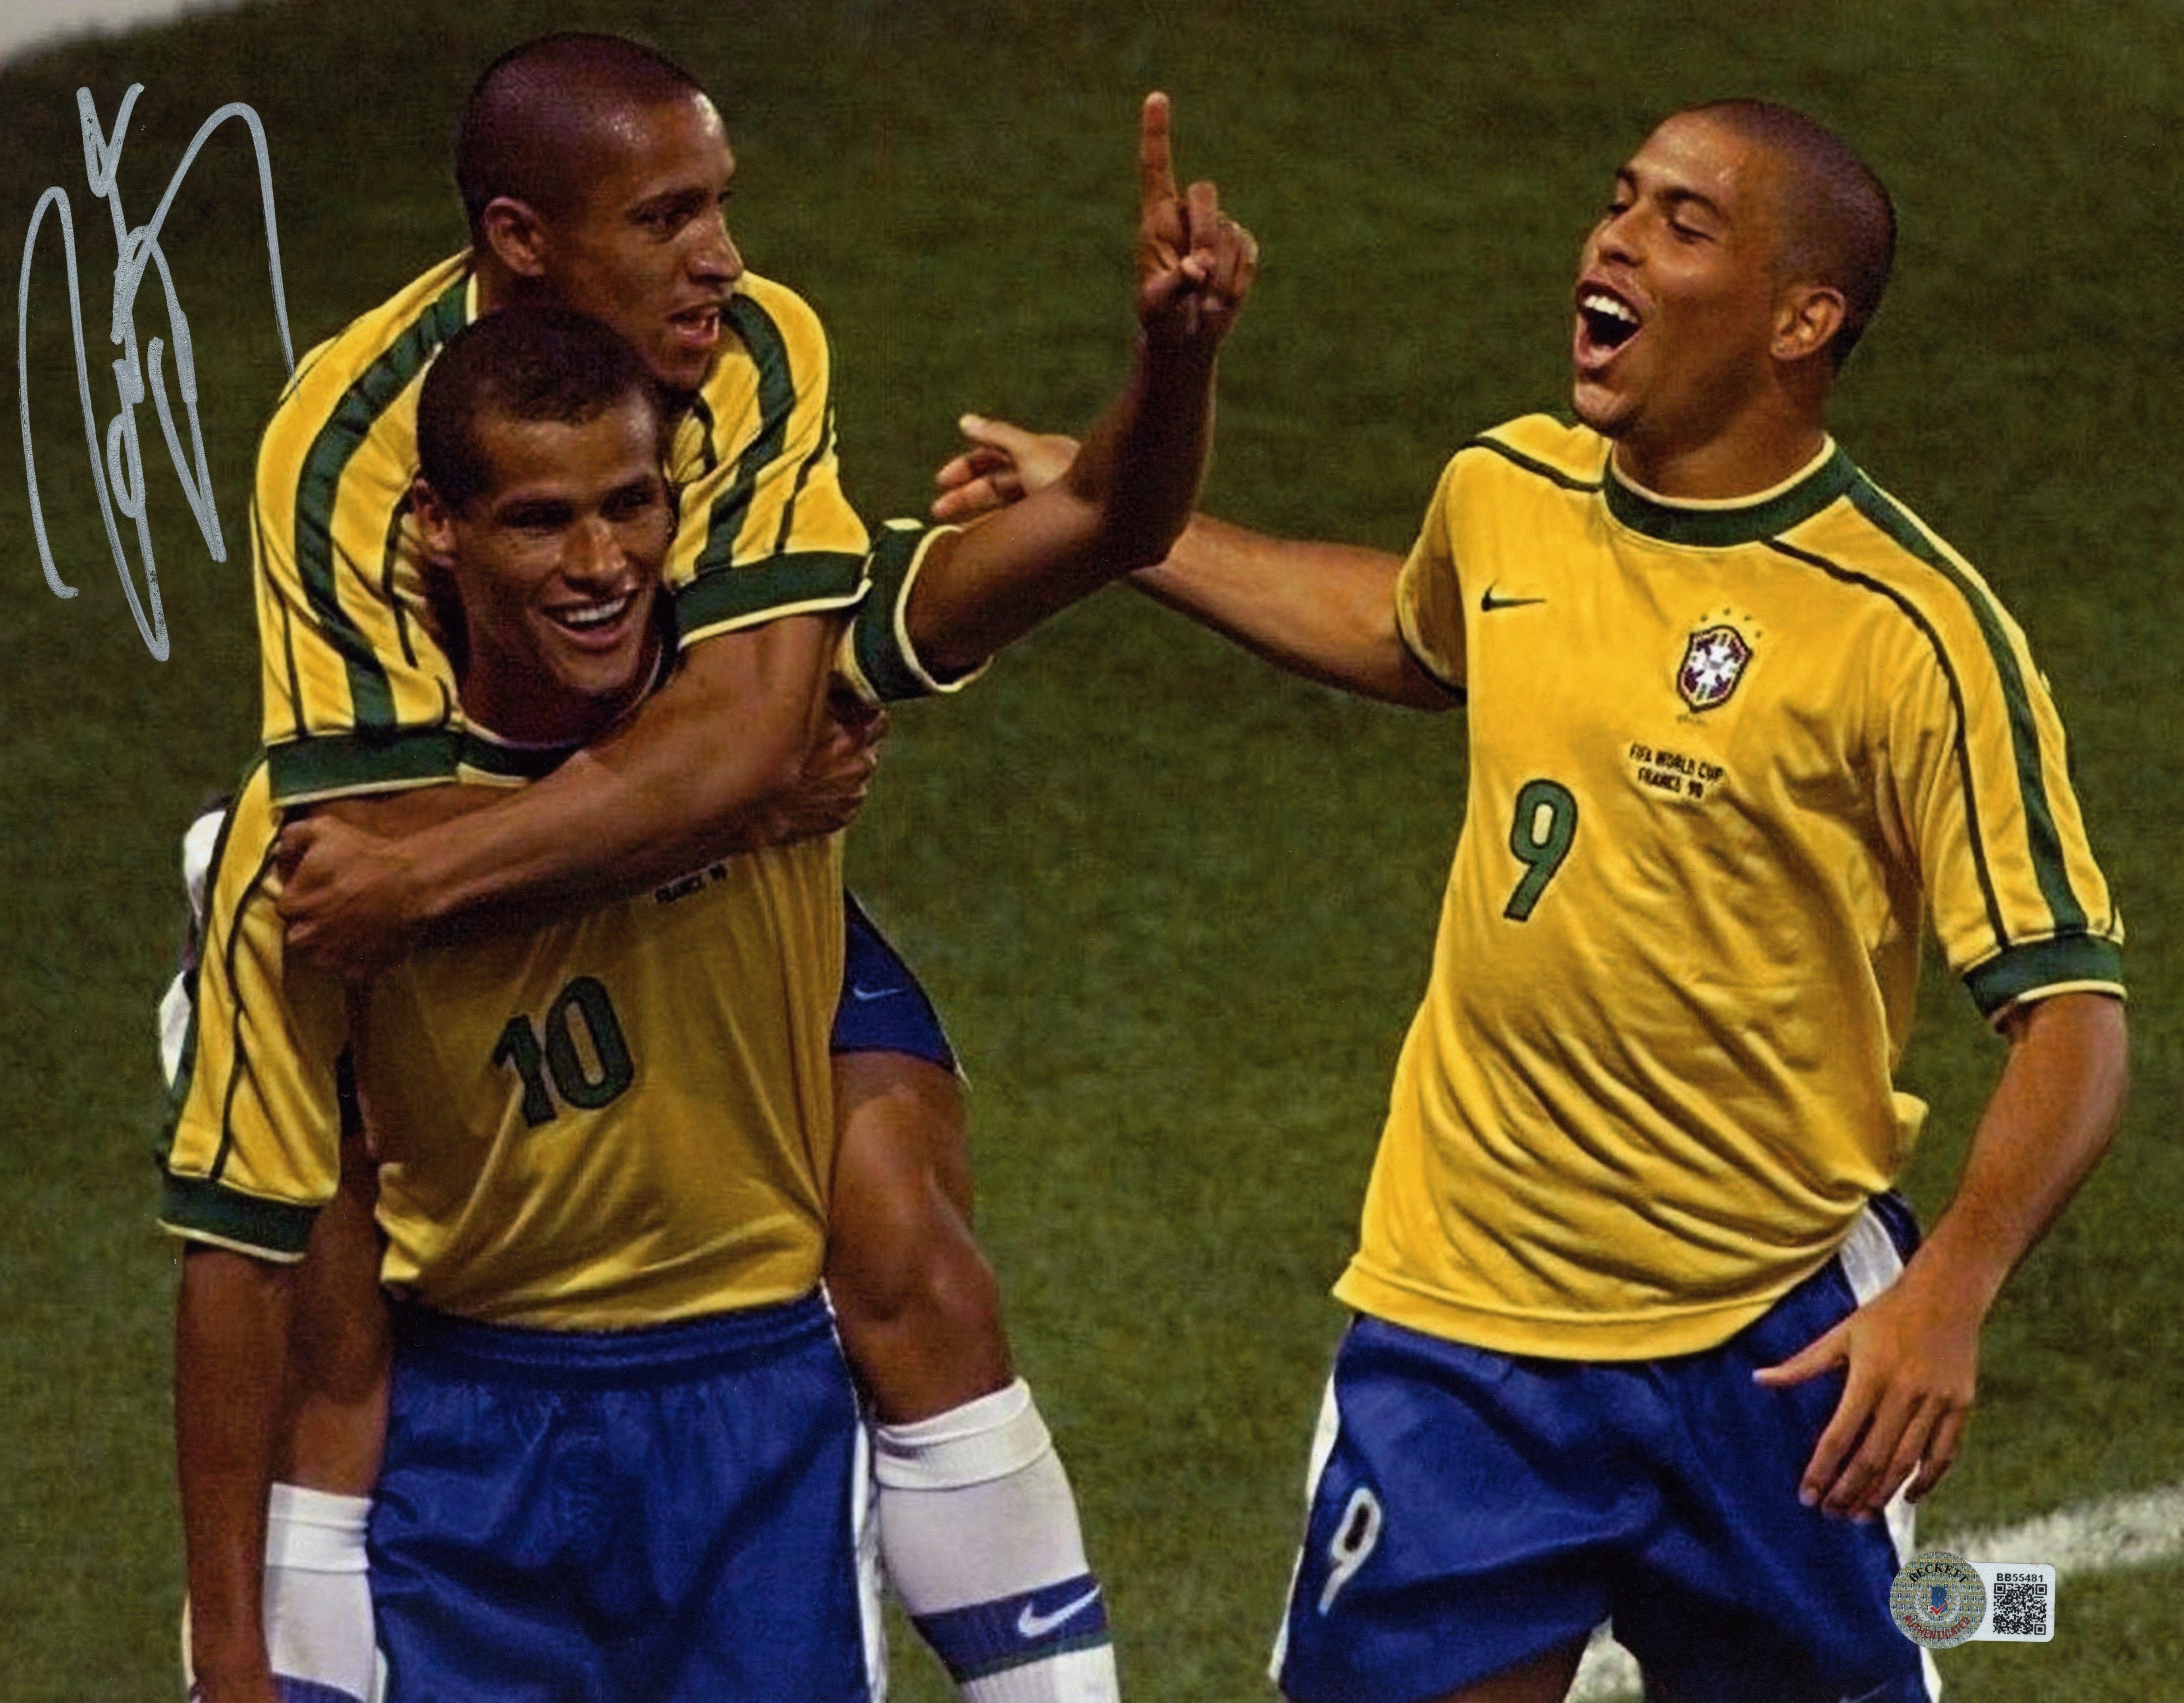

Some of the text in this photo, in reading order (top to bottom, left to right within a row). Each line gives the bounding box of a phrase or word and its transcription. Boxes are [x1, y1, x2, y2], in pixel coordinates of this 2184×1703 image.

[1698, 762, 1724, 780] CUP
[1503, 778, 1578, 922] 9
[492, 976, 635, 1128] 10
[1317, 1487, 1382, 1617] 9
[1909, 1563, 1969, 1584] BECKETT
[1997, 1574, 2043, 1582] BB55481
[1902, 1615, 1971, 1639] AUTHENTICATED
